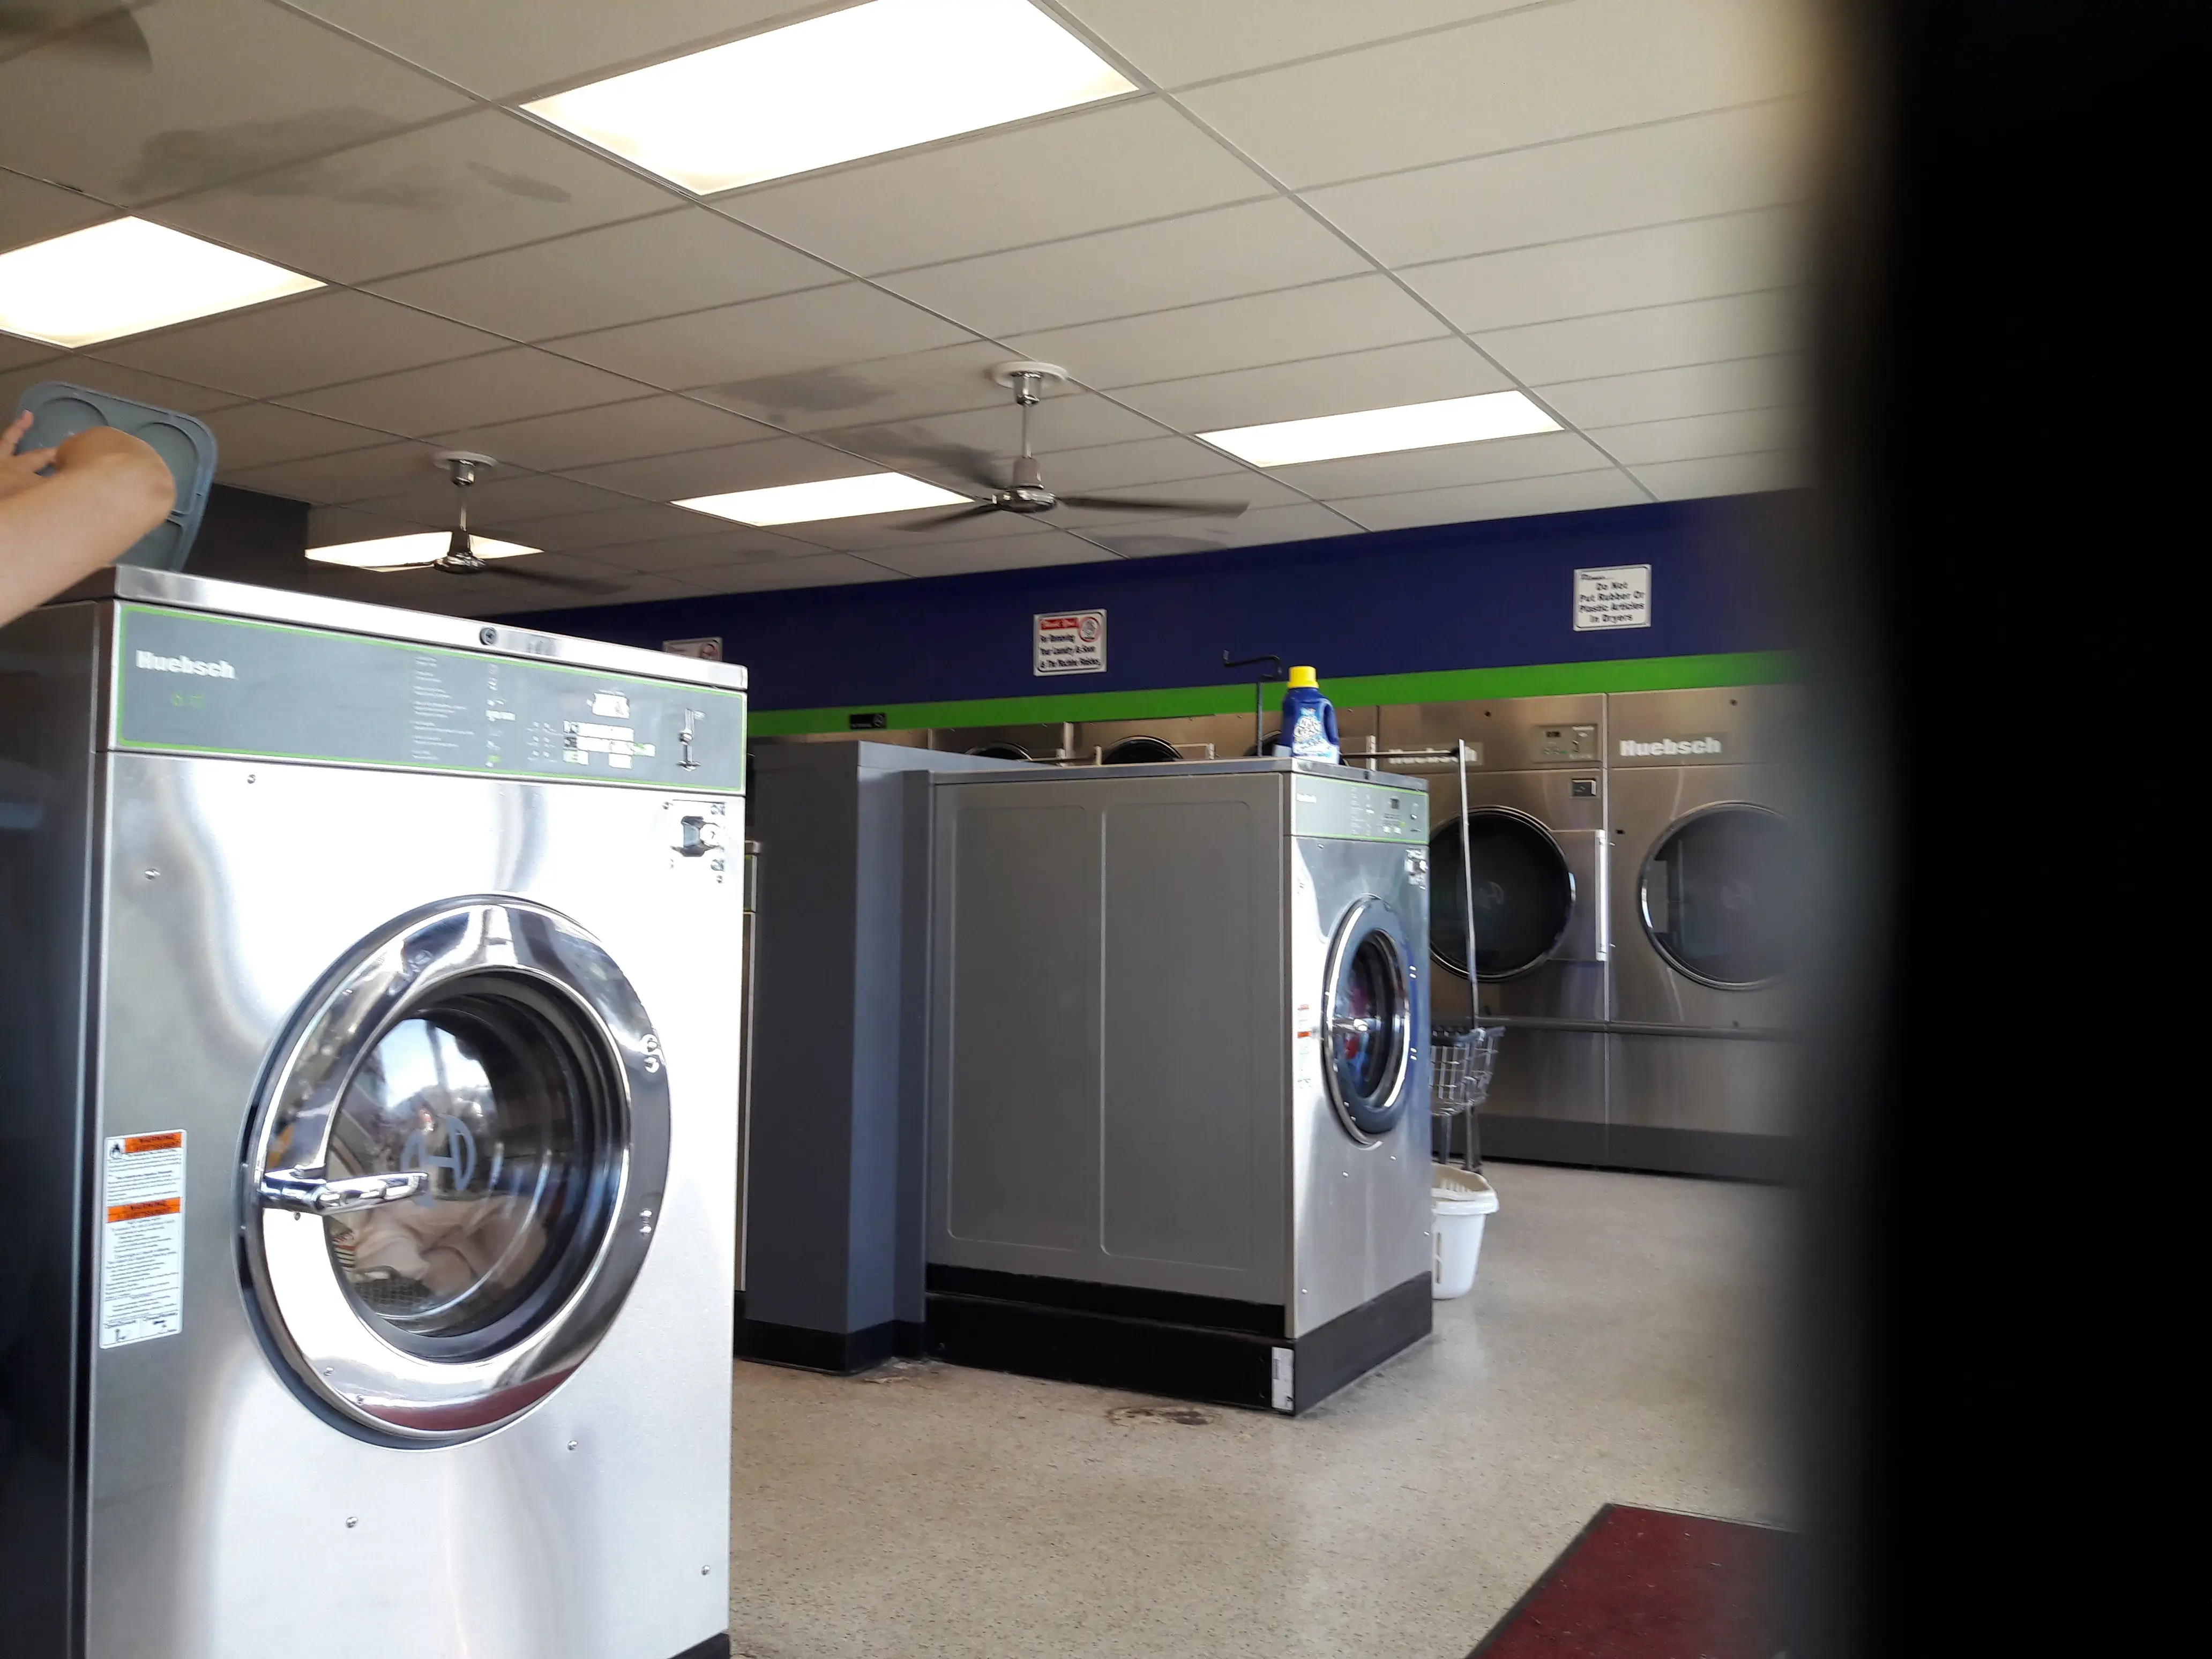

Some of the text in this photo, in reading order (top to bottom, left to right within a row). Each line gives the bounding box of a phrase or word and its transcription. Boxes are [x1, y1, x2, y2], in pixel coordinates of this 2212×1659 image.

[1596, 581, 1628, 591] Do Not
[1580, 591, 1645, 602] Put Rubber Or
[1580, 602, 1645, 612] Plastic Articles
[1589, 614, 1634, 624] In Dryers
[136, 649, 237, 680] Huebsch
[1620, 736, 1722, 757] Huebsch
